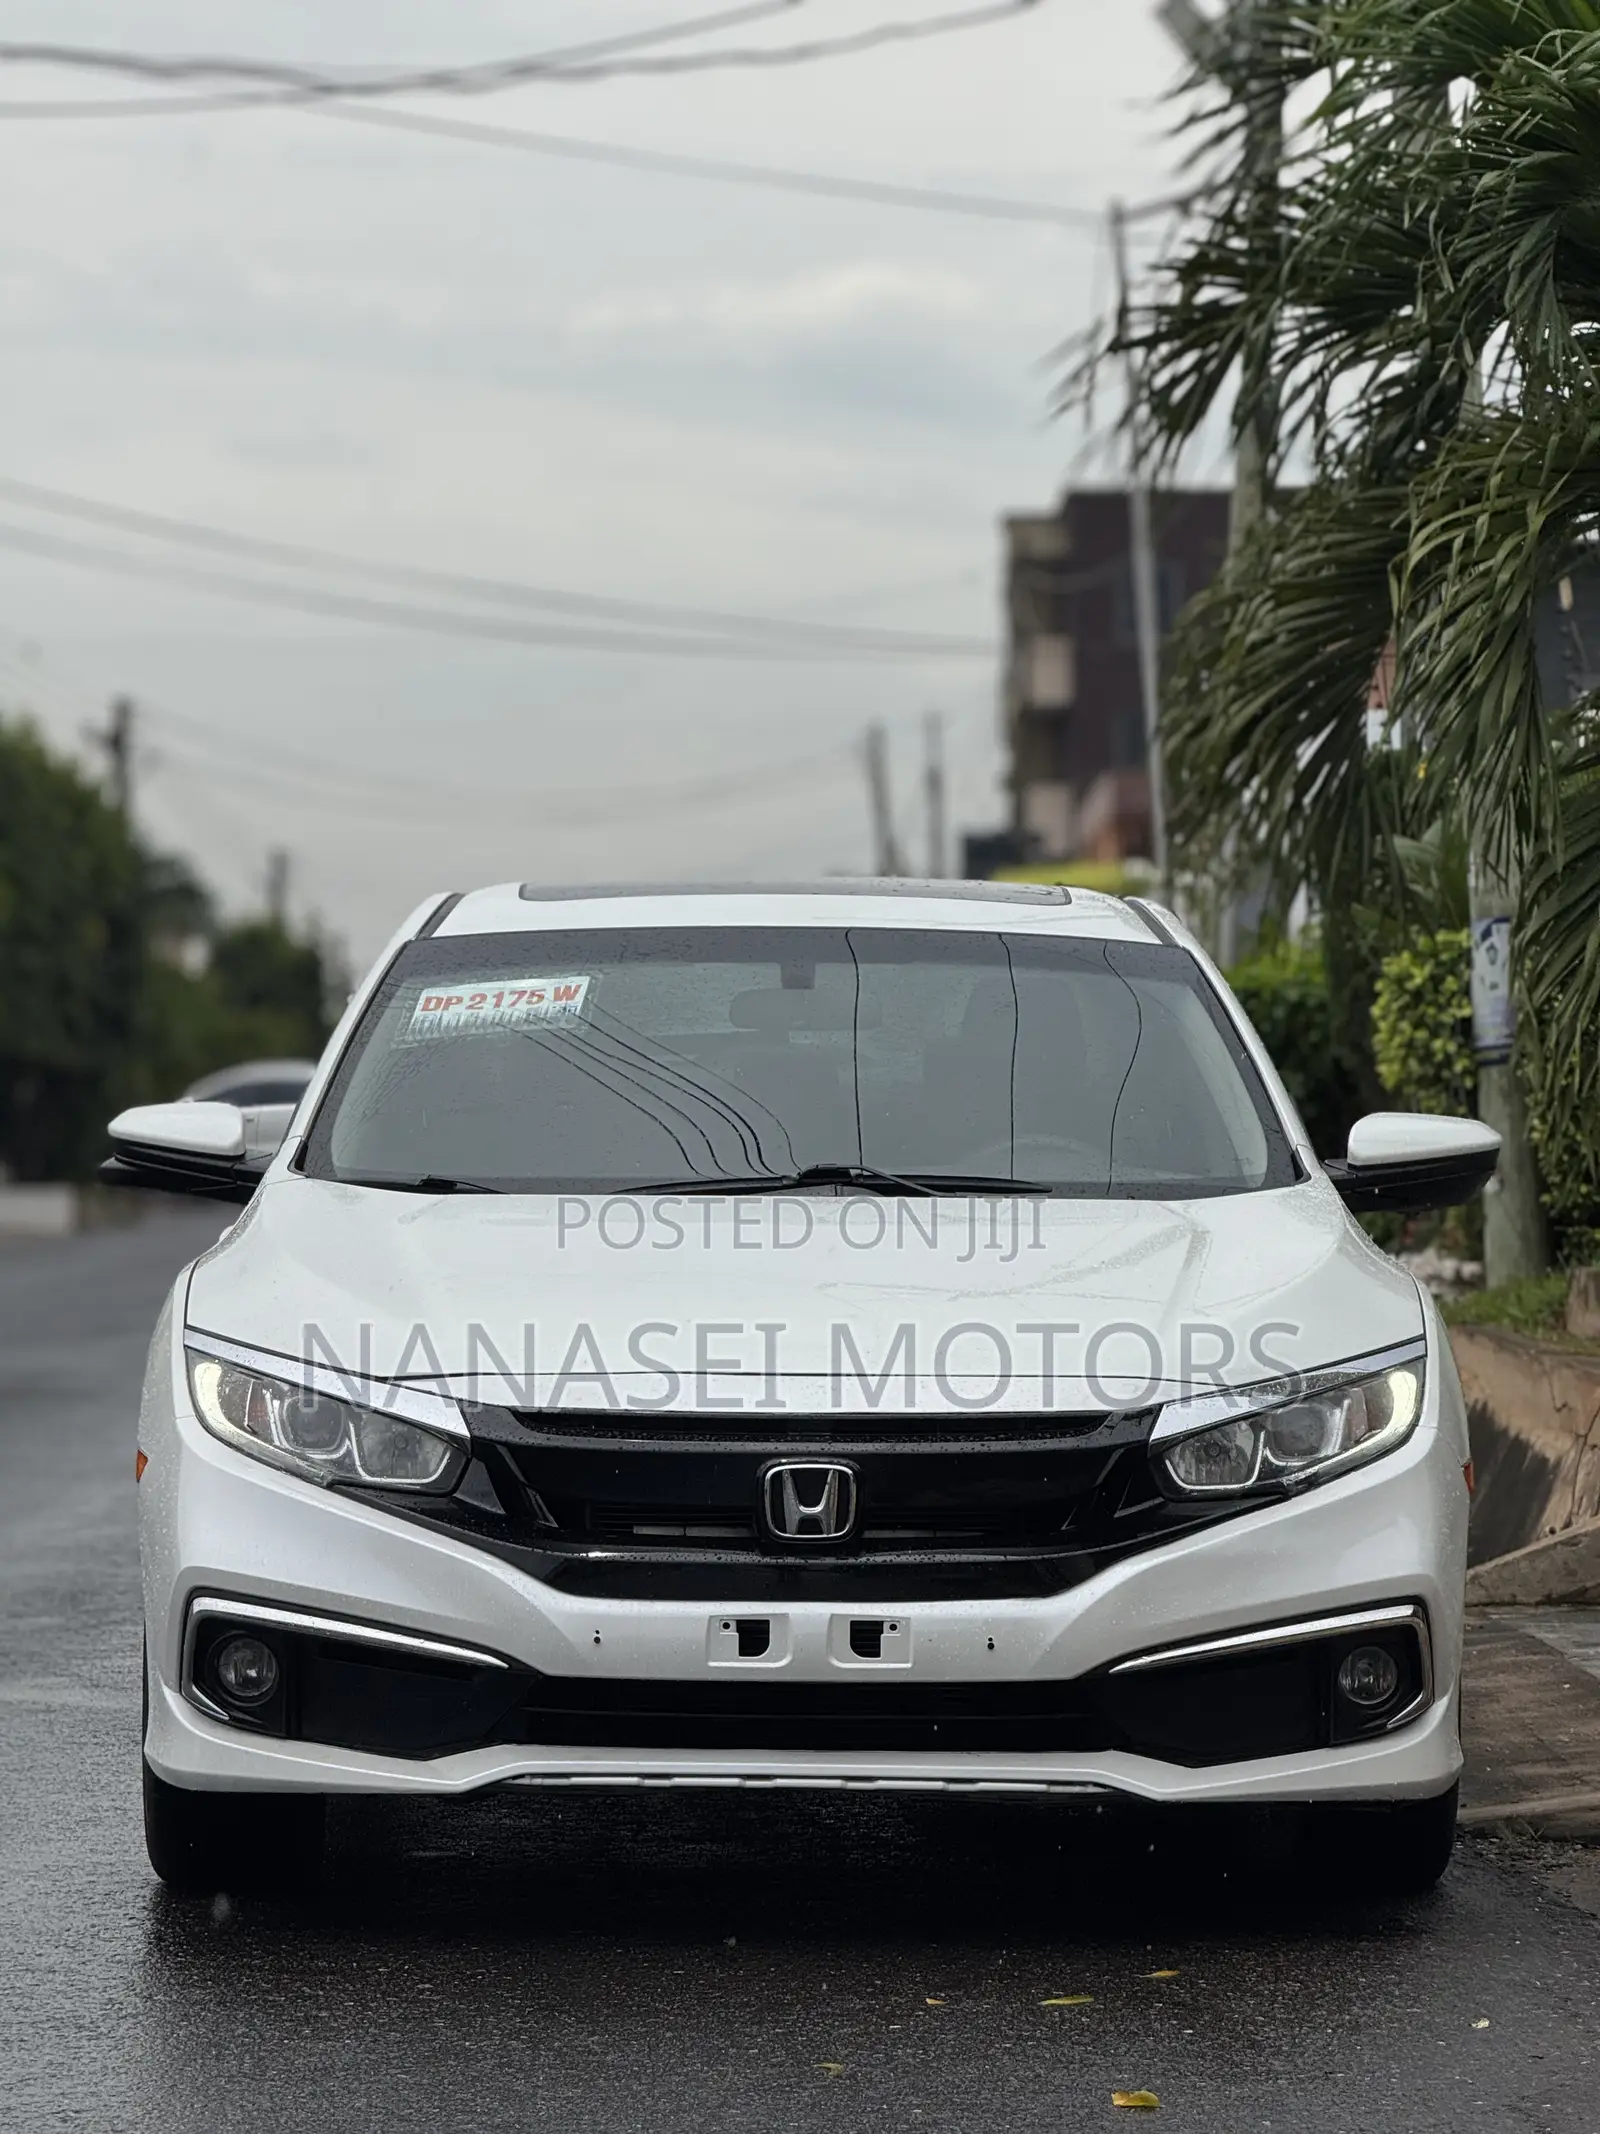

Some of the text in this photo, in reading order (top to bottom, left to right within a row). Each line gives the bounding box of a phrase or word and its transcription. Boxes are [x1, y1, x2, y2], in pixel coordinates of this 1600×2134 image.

[421, 984, 582, 1012] DP 2175 W
